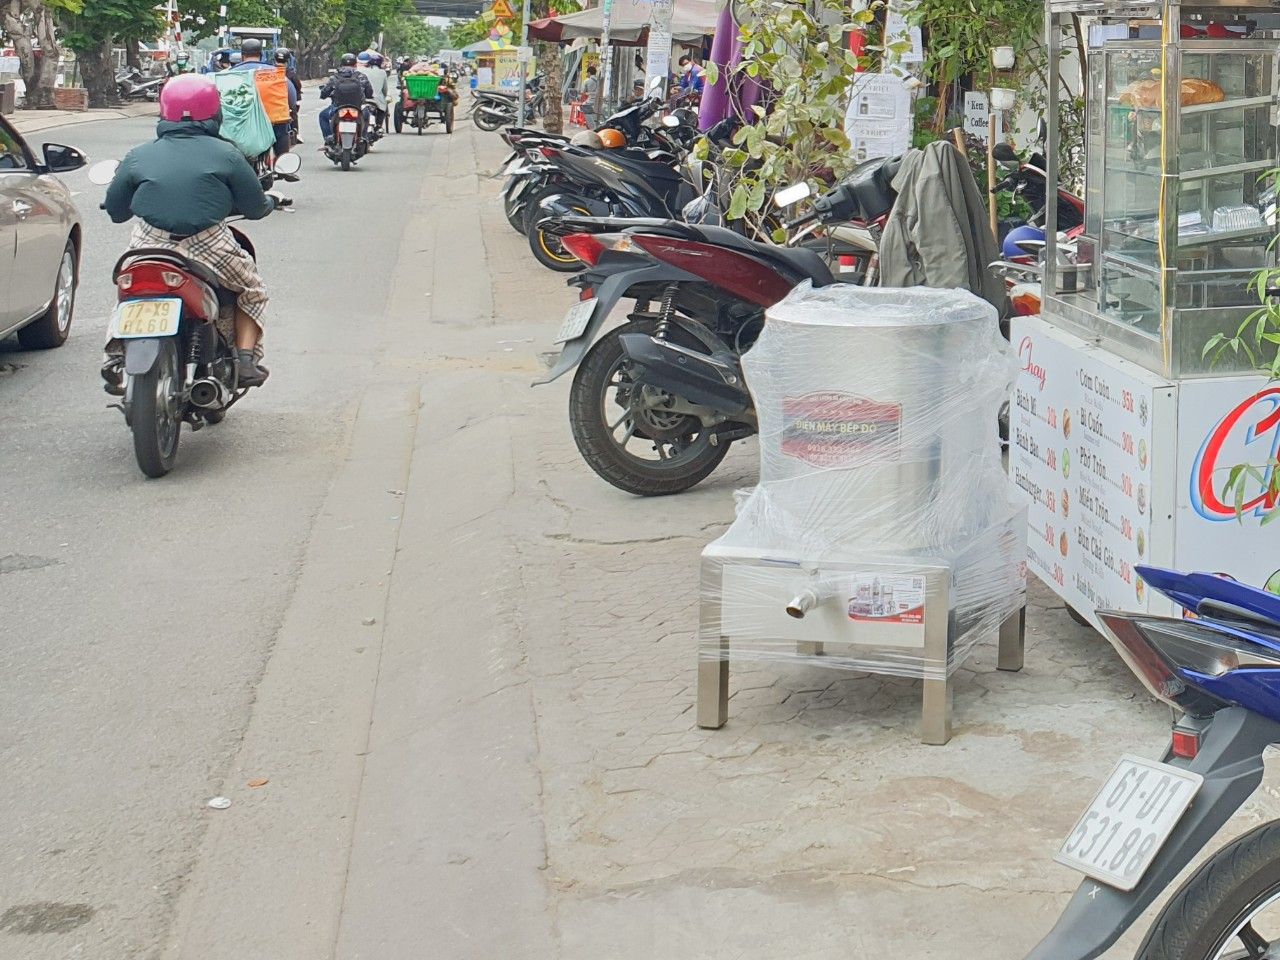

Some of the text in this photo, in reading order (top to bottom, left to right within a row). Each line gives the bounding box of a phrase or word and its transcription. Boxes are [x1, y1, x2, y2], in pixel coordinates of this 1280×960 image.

[1121, 431, 1134, 457] 30k
[1120, 514, 1132, 541] 30k
[1119, 558, 1131, 585] 30k
